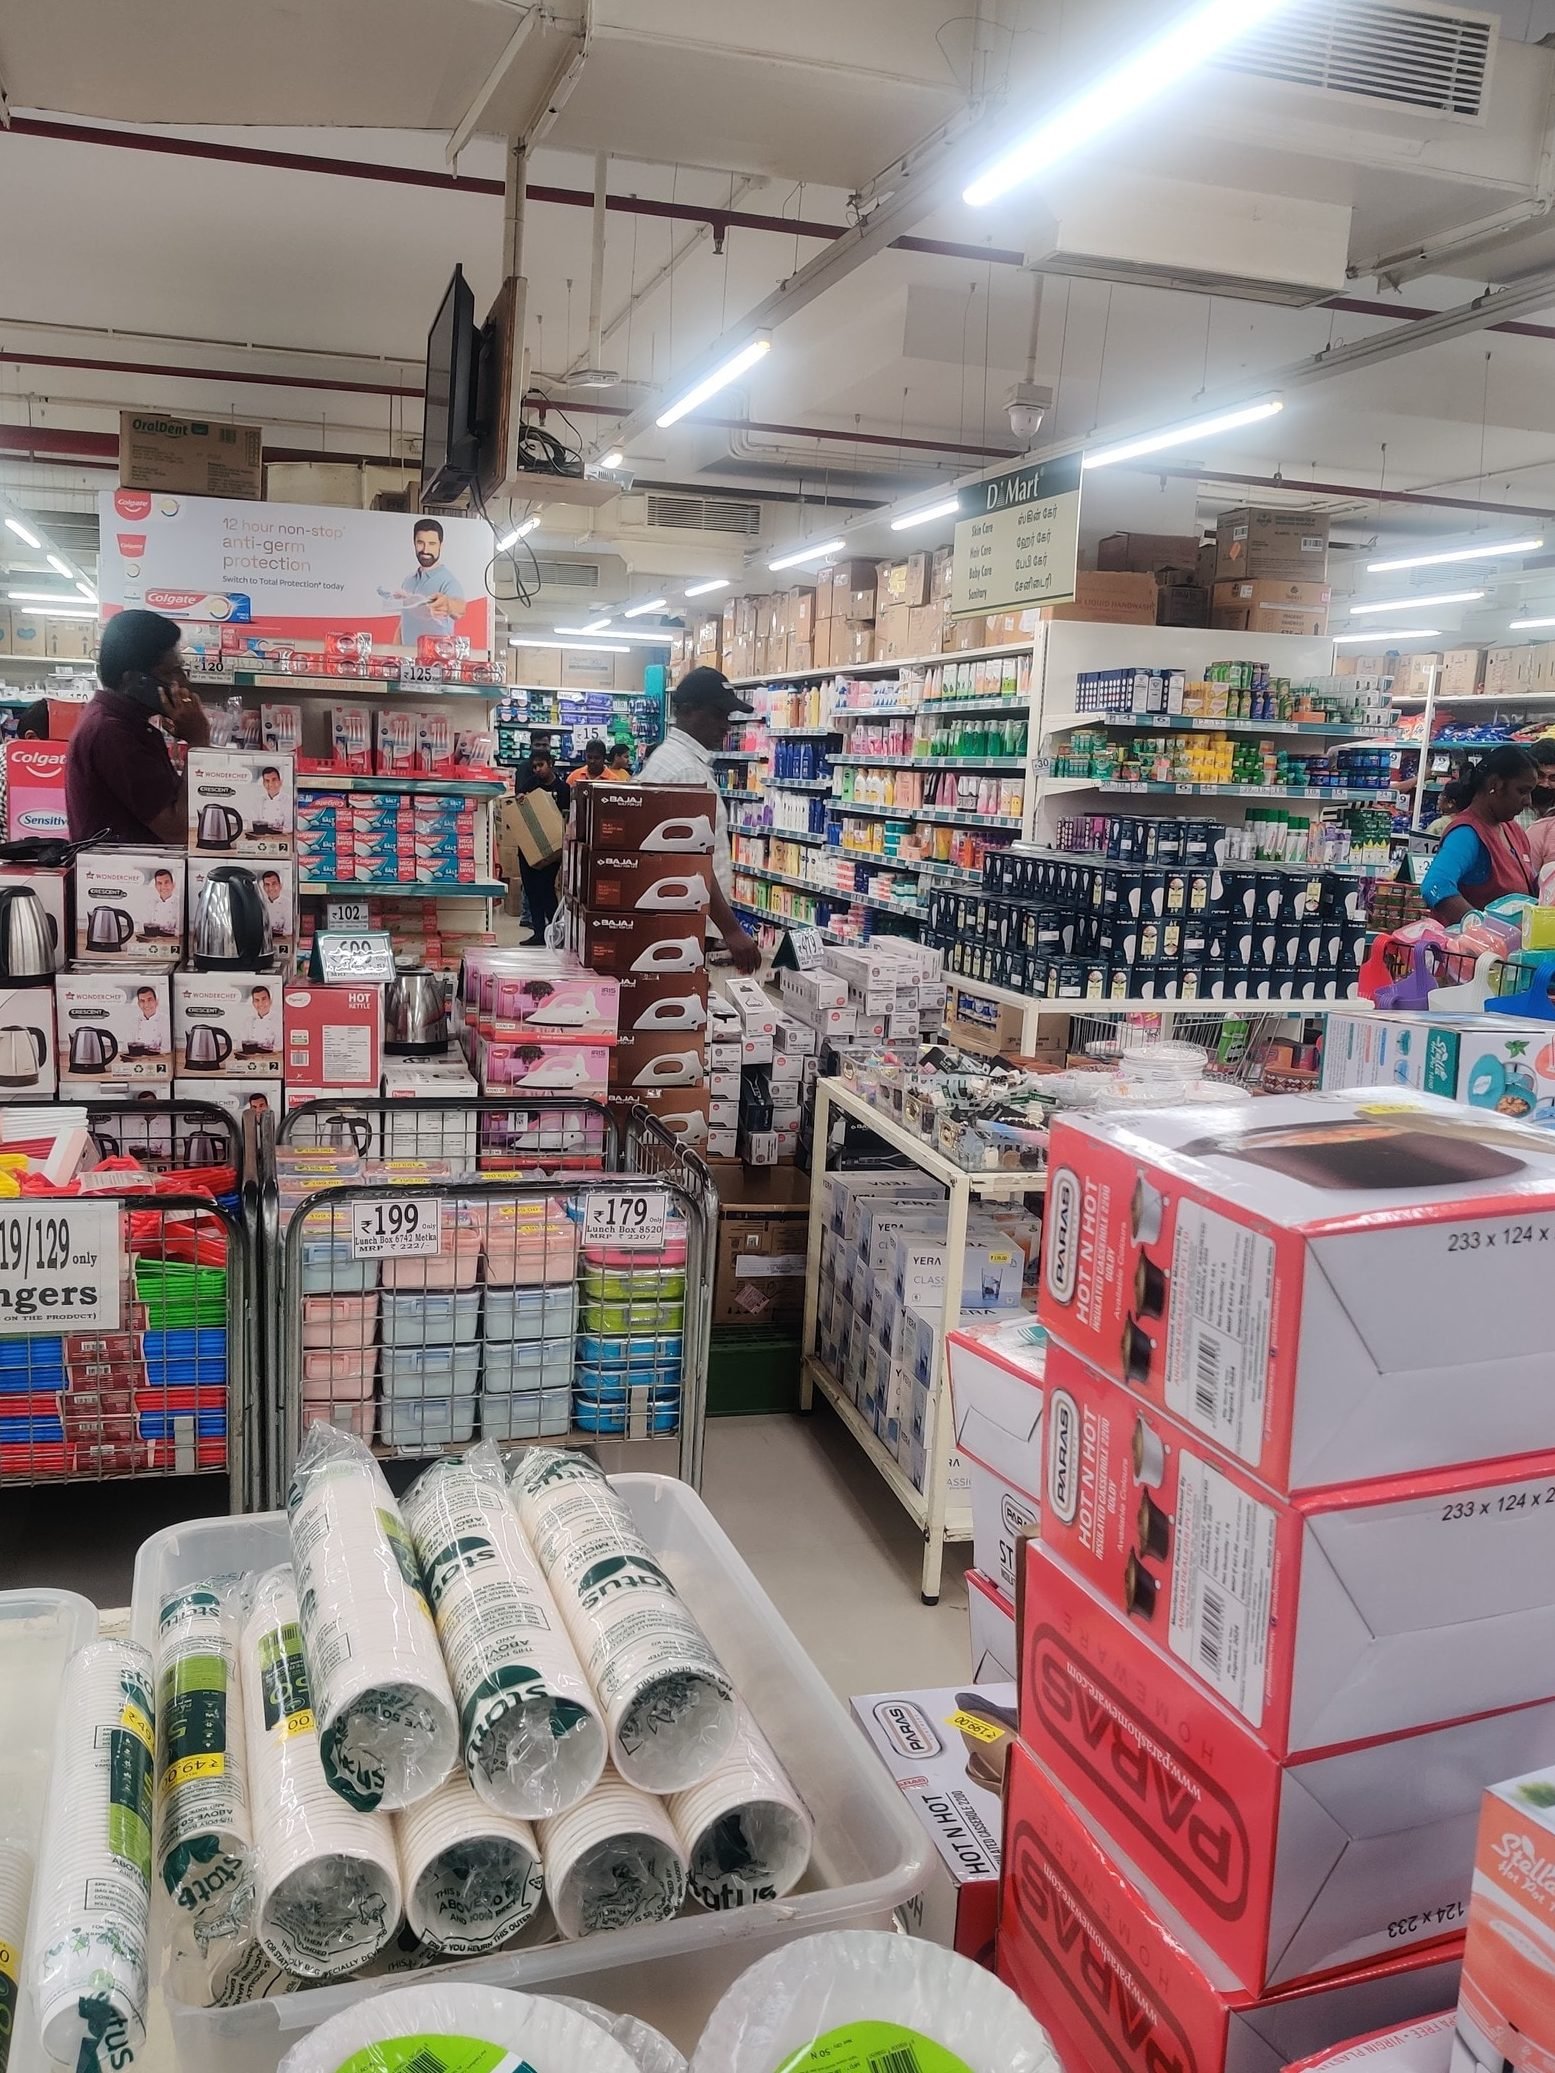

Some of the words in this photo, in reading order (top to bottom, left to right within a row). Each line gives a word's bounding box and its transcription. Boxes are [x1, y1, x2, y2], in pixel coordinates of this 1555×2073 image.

[132, 418, 188, 436] OralDent
[117, 498, 149, 509] Colgate
[223, 518, 238, 531] 12
[242, 519, 275, 534] hour
[982, 523, 993, 535] Care
[223, 535, 305, 554] anti-germ
[981, 546, 992, 556] Care
[223, 555, 311, 573] protection
[969, 566, 981, 581] Baby
[981, 566, 992, 577] Care
[222, 575, 249, 585] Switch
[250, 577, 258, 585] to
[259, 577, 278, 586] Total
[323, 582, 345, 591] today
[147, 592, 197, 605] Colgate
[968, 587, 987, 601] Sanitary
[403, 667, 432, 682] ₹125
[11, 751, 66, 765] Colgat
[1391, 753, 1398, 762] 9
[206, 771, 248, 780] WONDERCHEF
[201, 786, 230, 794] CRESCENT
[24, 815, 68, 826] Sensitiv
[605, 859, 638, 867] BAJAJ
[96, 873, 141, 882] WONDERCHEF
[92, 888, 122, 897] CRESCENT
[332, 906, 360, 921] ₹102
[601, 920, 634, 928] BAJAJ
[76, 993, 123, 1001] WONDERCHEF
[193, 992, 237, 1000] WONDERCHEF
[348, 993, 371, 1004] HOT
[188, 1007, 218, 1015] CRESCENT
[609, 1094, 640, 1102] BAJAJ
[593, 1197, 648, 1226] ₹179
[1082, 1176, 1098, 1235] HOT
[361, 1203, 419, 1236] ₹199
[587, 1226, 615, 1234] Lunch
[619, 1226, 636, 1234] Box
[639, 1225, 662, 1234] 8520
[1056, 1186, 1071, 1284] PARAS
[355, 1236, 378, 1245] Lunch
[380, 1235, 393, 1244] Box
[395, 1234, 413, 1244] 6742
[1448, 1231, 1480, 1252] 233
[1487, 1234, 1496, 1247] x
[1504, 1225, 1533, 1244] 124
[359, 1245, 384, 1253] MRP
[1082, 1242, 1094, 1262] N
[72, 1252, 97, 1265] only
[913, 1256, 942, 1265] YERA
[914, 1275, 945, 1285] CLASS
[1076, 1265, 1091, 1325] HOT
[46, 1312, 97, 1321] PRODUCT)
[1083, 1404, 1097, 1463] HOT
[1056, 1408, 1069, 1504] PARAS
[1081, 1466, 1095, 1490] N
[1098, 1447, 1109, 1505] CASSEROLE
[1120, 1457, 1128, 1501] Colours
[1442, 1502, 1475, 1522] 233
[1480, 1504, 1490, 1516] x
[1498, 1494, 1527, 1514] 124
[1078, 1490, 1093, 1549] HOT
[1094, 1504, 1106, 1561] INSULATED
[1116, 1503, 1127, 1553] Available
[1180, 1532, 1192, 1584] DEALERS
[159, 1601, 221, 1627] statu
[1177, 1583, 1188, 1632] ANUPAM
[125, 1707, 154, 1742] ₹49
[889, 1707, 925, 1751] PARAS
[1066, 1660, 1202, 1803] www.parashomeware.com
[1042, 1651, 1232, 1887] PARAS
[921, 1794, 958, 1824] HOT
[965, 1805, 992, 1838] CASSEROLE
[946, 1826, 967, 1839] N
[951, 1843, 991, 1875] HOT
[1499, 1860, 1520, 1884] Hot
[1521, 1878, 1545, 1904] Pot
[435, 1887, 456, 1899] THIS
[439, 1897, 481, 1914] ABOVE
[1437, 1901, 1464, 1924] 124
[1422, 1912, 1431, 1924] x
[448, 1942, 466, 1952] YOU
[493, 1928, 509, 1943] THIS
[508, 1913, 533, 1932] OUTER
[1387, 1915, 1418, 1939] 233
[1042, 1862, 1159, 2028] www.parashomeware.com
[1409, 2023, 1441, 2039] FREE
[1362, 2034, 1405, 2054] VIRGIN
[809, 2052, 818, 2061] N
[818, 2047, 831, 2058] 50
[1317, 2048, 1364, 2072] PLASTI
